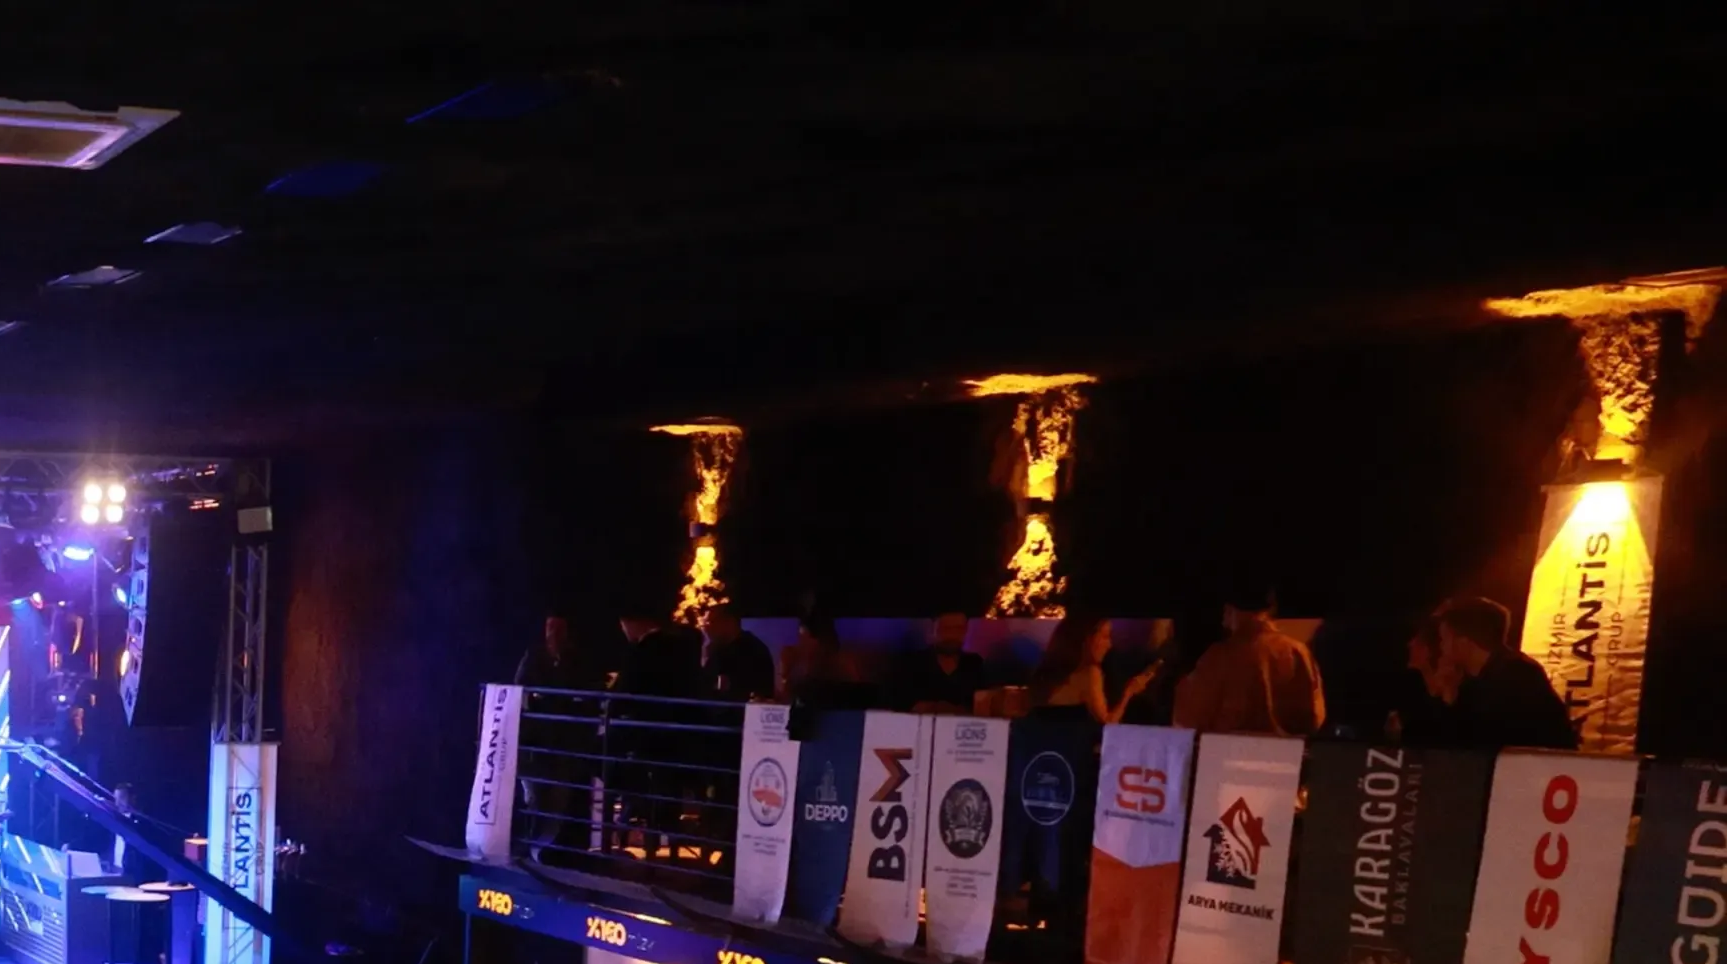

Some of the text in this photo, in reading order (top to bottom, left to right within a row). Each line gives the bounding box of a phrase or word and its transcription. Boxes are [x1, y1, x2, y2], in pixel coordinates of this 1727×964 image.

[231, 791, 252, 889] LANTİS
[804, 803, 849, 823] DEPPO
[867, 748, 913, 882] BSM
[1349, 748, 1404, 937] KARAGÖZ
[1188, 894, 1275, 921] ARYA MEKANİK
